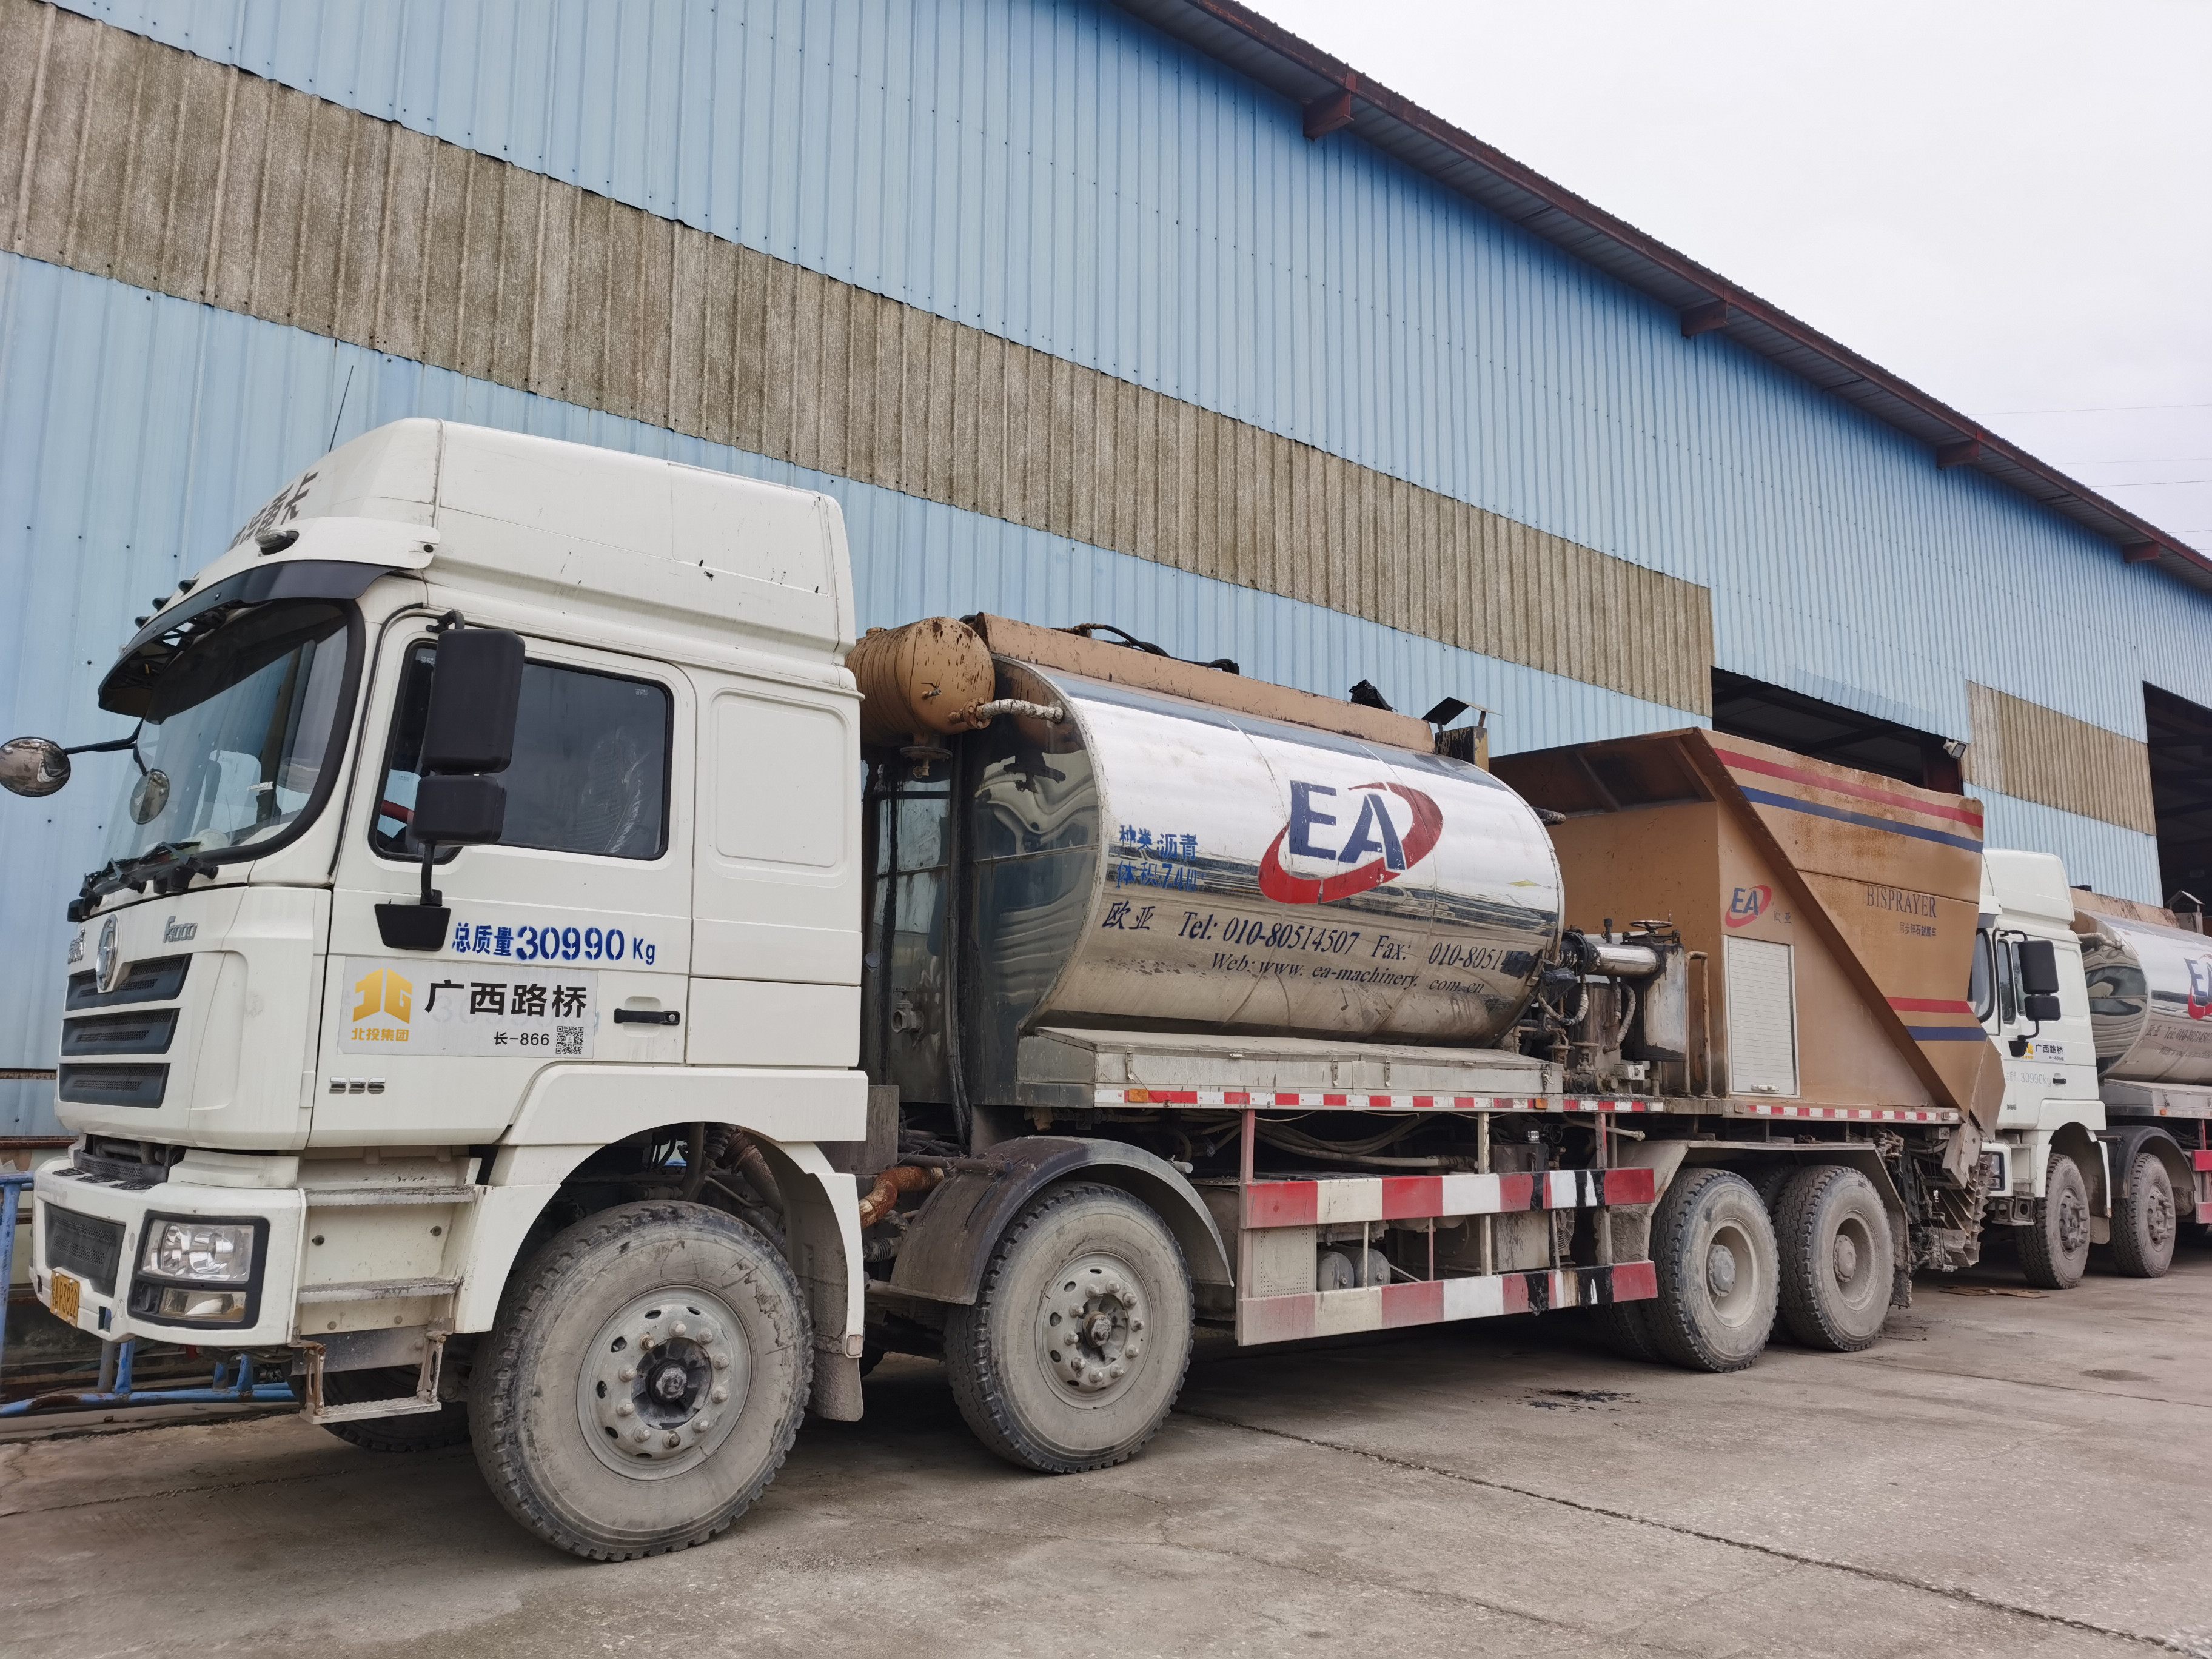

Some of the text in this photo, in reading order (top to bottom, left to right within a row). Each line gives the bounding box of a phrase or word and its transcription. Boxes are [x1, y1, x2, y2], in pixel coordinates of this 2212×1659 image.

[1289, 780, 1407, 871] EA
[1731, 888, 1758, 916] EA
[1866, 885, 1937, 918] BISPRAYER
[163, 916, 198, 943] F3000
[1102, 900, 1156, 930] 欧亚
[1178, 911, 1218, 940] Tel:
[1223, 917, 1361, 955] 010-80514507
[1370, 935, 1411, 961] Fax:
[1212, 953, 1255, 973] Web:
[425, 979, 587, 1019] 广西路桥
[351, 1028, 409, 1042] 北投集团
[494, 1031, 549, 1046] 长-866
[2036, 1044, 2063, 1054] 广西路桥
[329, 1076, 386, 1094] 336
